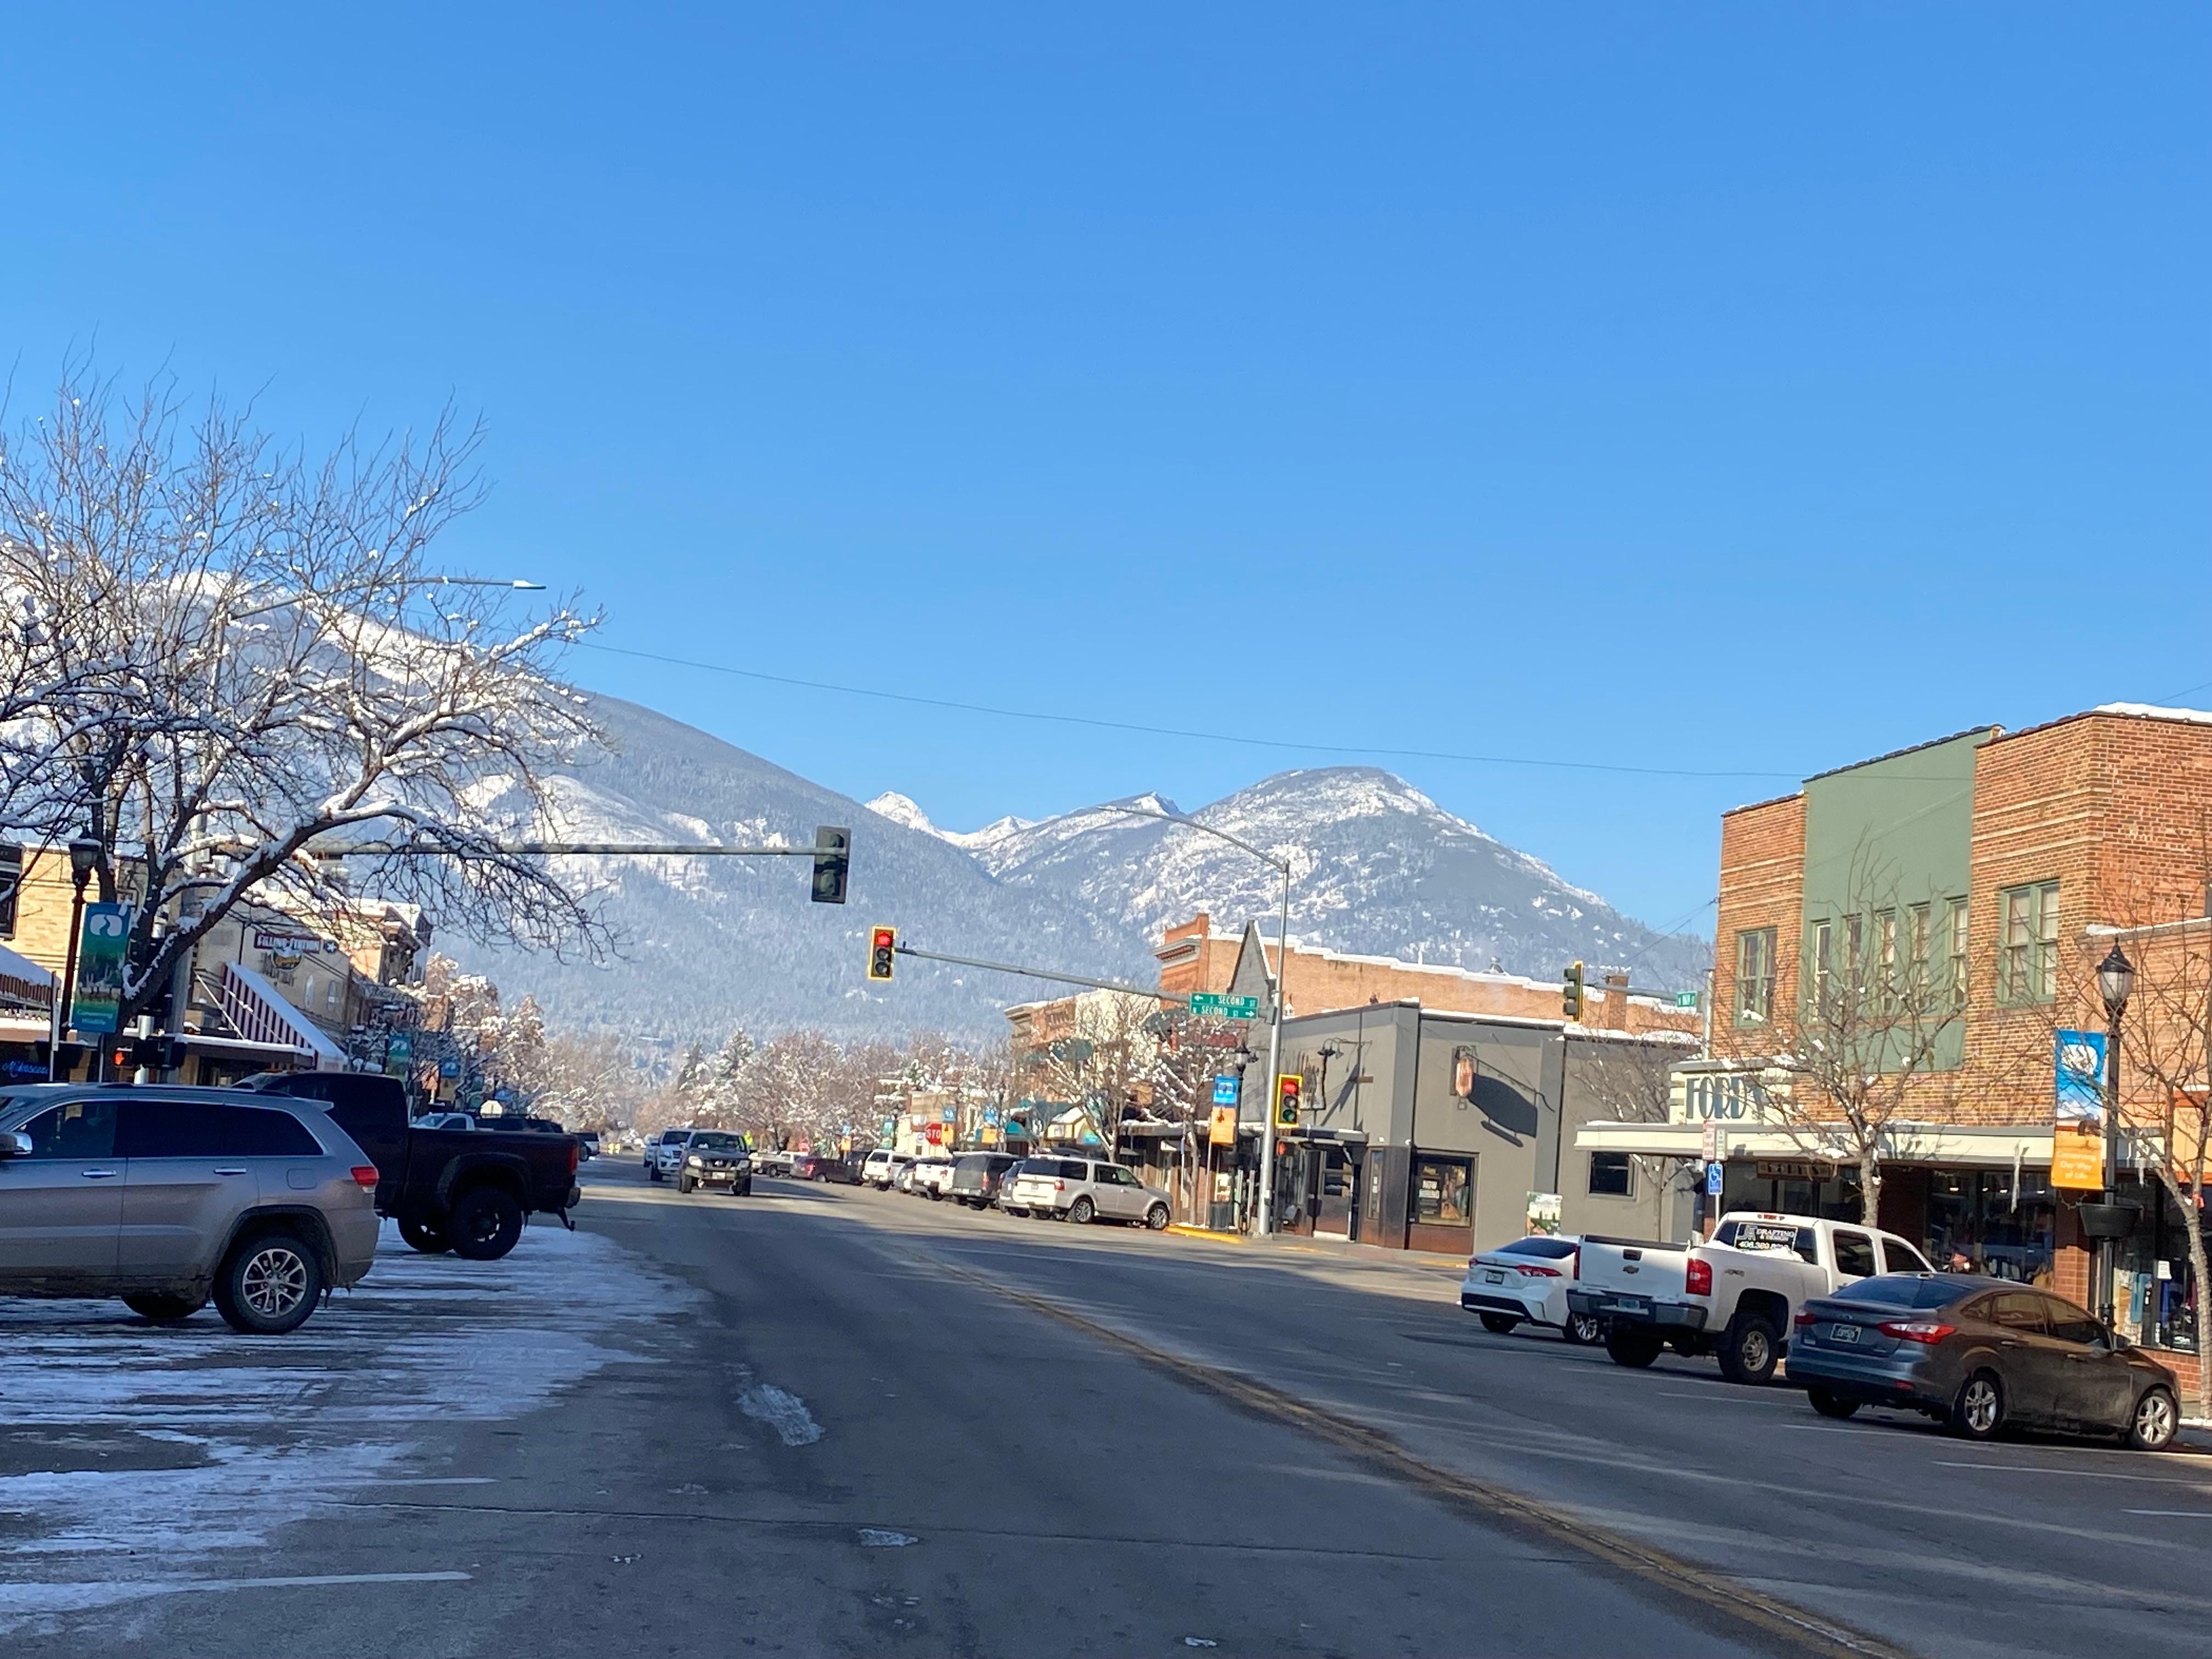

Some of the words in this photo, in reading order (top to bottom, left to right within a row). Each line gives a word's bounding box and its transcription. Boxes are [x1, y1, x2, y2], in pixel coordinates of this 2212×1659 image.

[1218, 995, 1245, 1006] SECOND
[1201, 1005, 1228, 1016] SECOND
[926, 1128, 941, 1139] STO
[1756, 1228, 1795, 1238] DRAFTING
